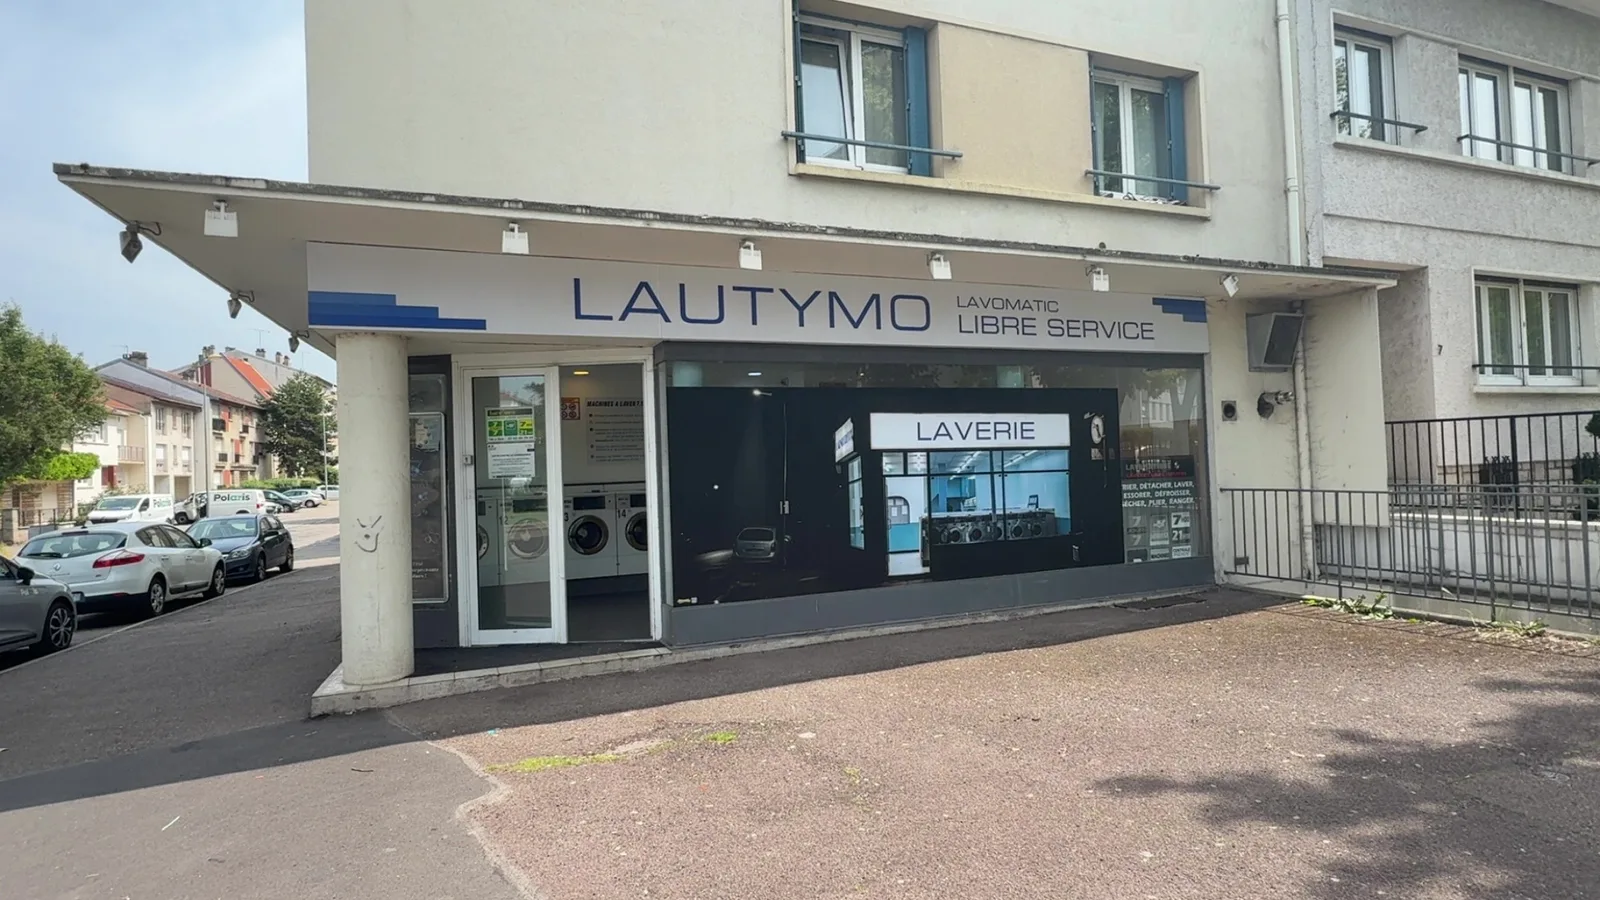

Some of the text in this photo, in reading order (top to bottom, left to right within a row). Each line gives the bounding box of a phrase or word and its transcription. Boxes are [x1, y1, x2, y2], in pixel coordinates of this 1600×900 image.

[573, 277, 931, 332] LAUTYMO
[956, 295, 1060, 313] LAVOMATIC
[958, 314, 1155, 341] LIBRE SERVICE
[1437, 344, 1443, 356] 7
[587, 400, 614, 408] MACHINES
[916, 421, 1036, 441] LAVERIE
[1173, 480, 1194, 488] LAVER,
[213, 493, 251, 502] Polaris
[617, 509, 627, 519] 14
[1172, 514, 1182, 525] 7
[1172, 530, 1183, 541] 21
